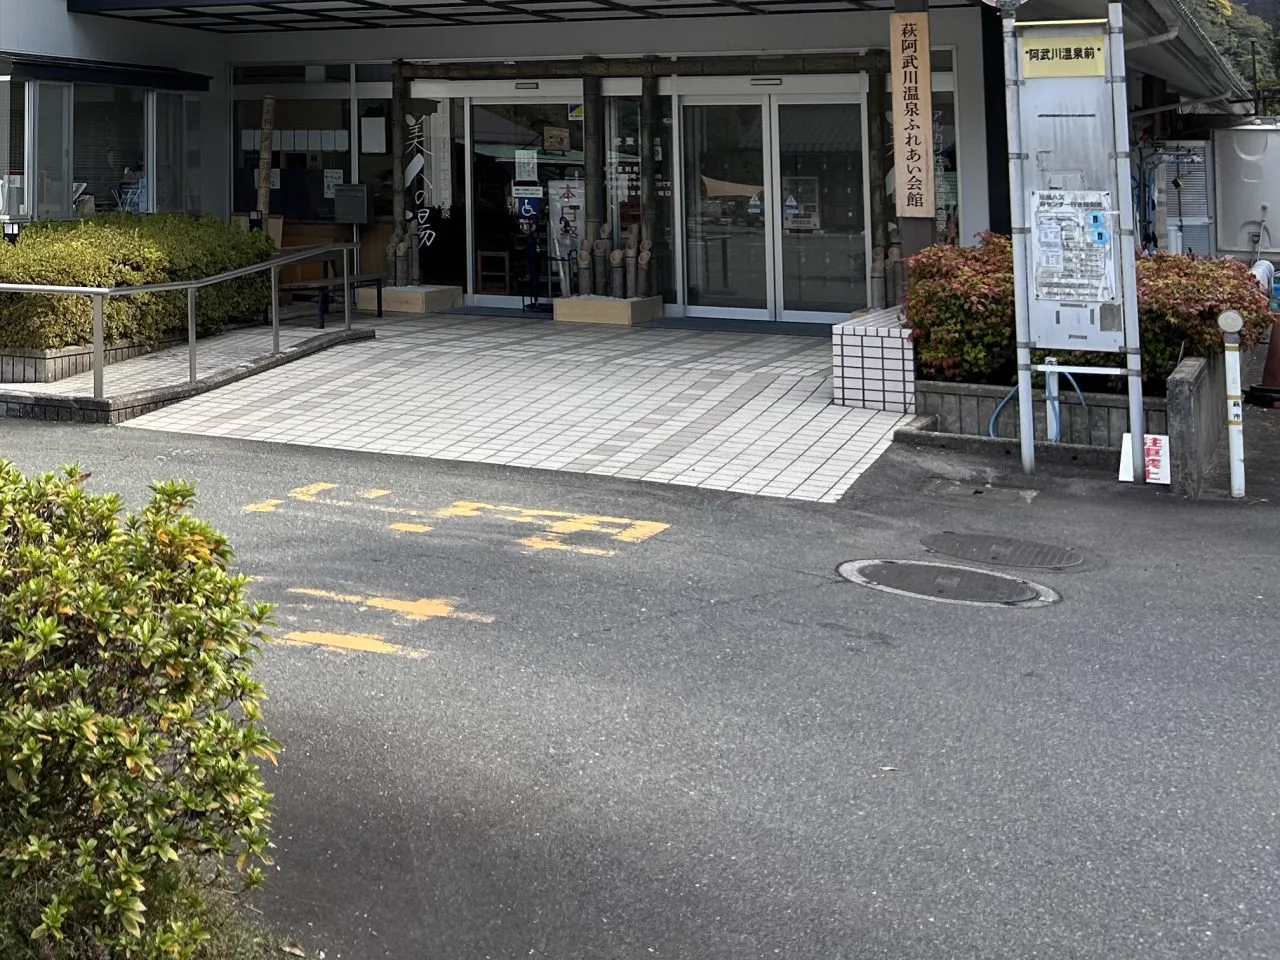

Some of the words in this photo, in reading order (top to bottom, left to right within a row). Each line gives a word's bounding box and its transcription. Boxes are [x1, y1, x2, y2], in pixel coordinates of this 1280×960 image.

[1029, 47, 1095, 60] 阿武川温泉前
[901, 23, 924, 208] 萩阿武川温泉ふれあい会館
